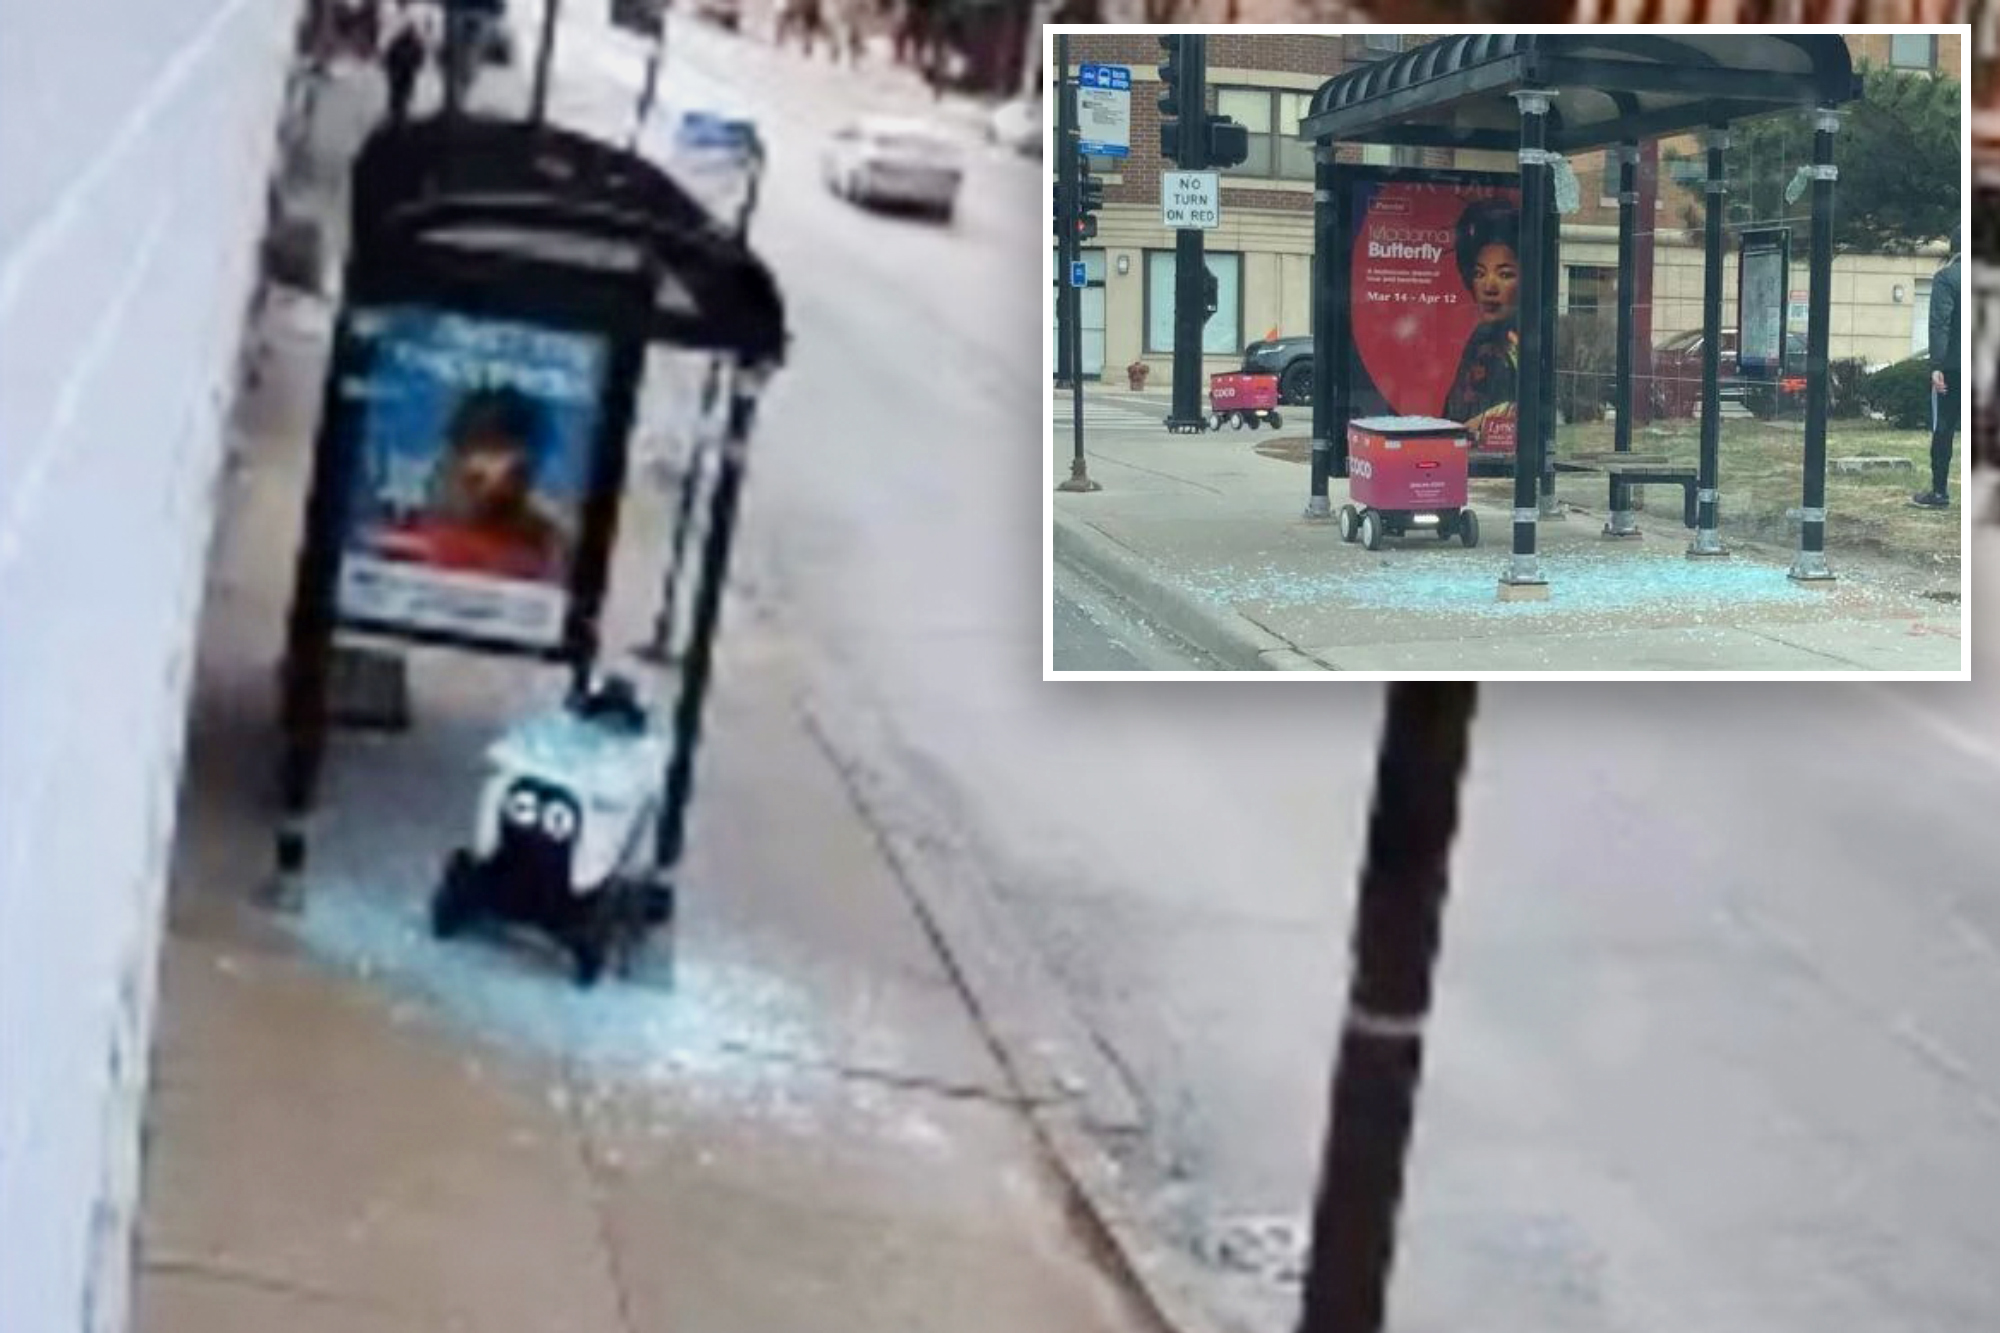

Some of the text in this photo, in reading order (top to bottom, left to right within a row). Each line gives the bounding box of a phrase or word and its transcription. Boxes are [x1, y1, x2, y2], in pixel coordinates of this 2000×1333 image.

[1179, 178, 1201, 190] NO
[1173, 193, 1208, 205] TURN
[1167, 209, 1215, 222] ON RED
[1368, 242, 1442, 263] Butterfly
[1367, 291, 1391, 302] Mar
[1394, 292, 1408, 302] 14
[1419, 292, 1440, 304] Apr
[1443, 293, 1457, 303] 12
